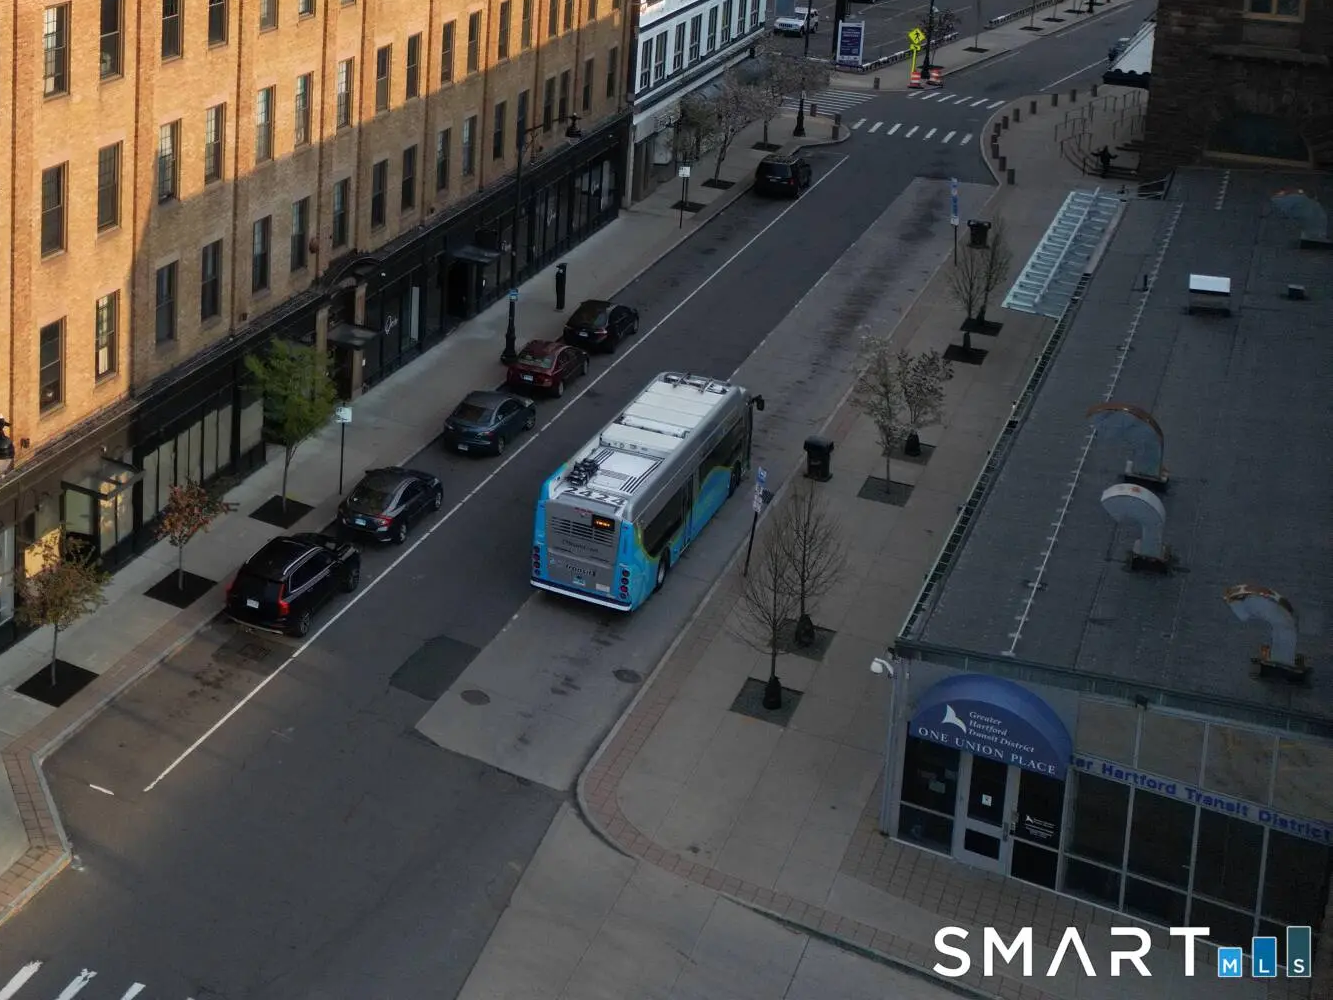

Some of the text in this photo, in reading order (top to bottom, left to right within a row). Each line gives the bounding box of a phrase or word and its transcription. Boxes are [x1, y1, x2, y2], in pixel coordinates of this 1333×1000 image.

[565, 486, 625, 505] 2424
[969, 711, 1003, 726] Greater
[969, 719, 1008, 736] Hartford
[918, 727, 1056, 775] ONE UNION PLACE
[968, 728, 1035, 753] Transit District
[1101, 762, 1177, 795] Hartford
[1184, 787, 1249, 816] Transit
